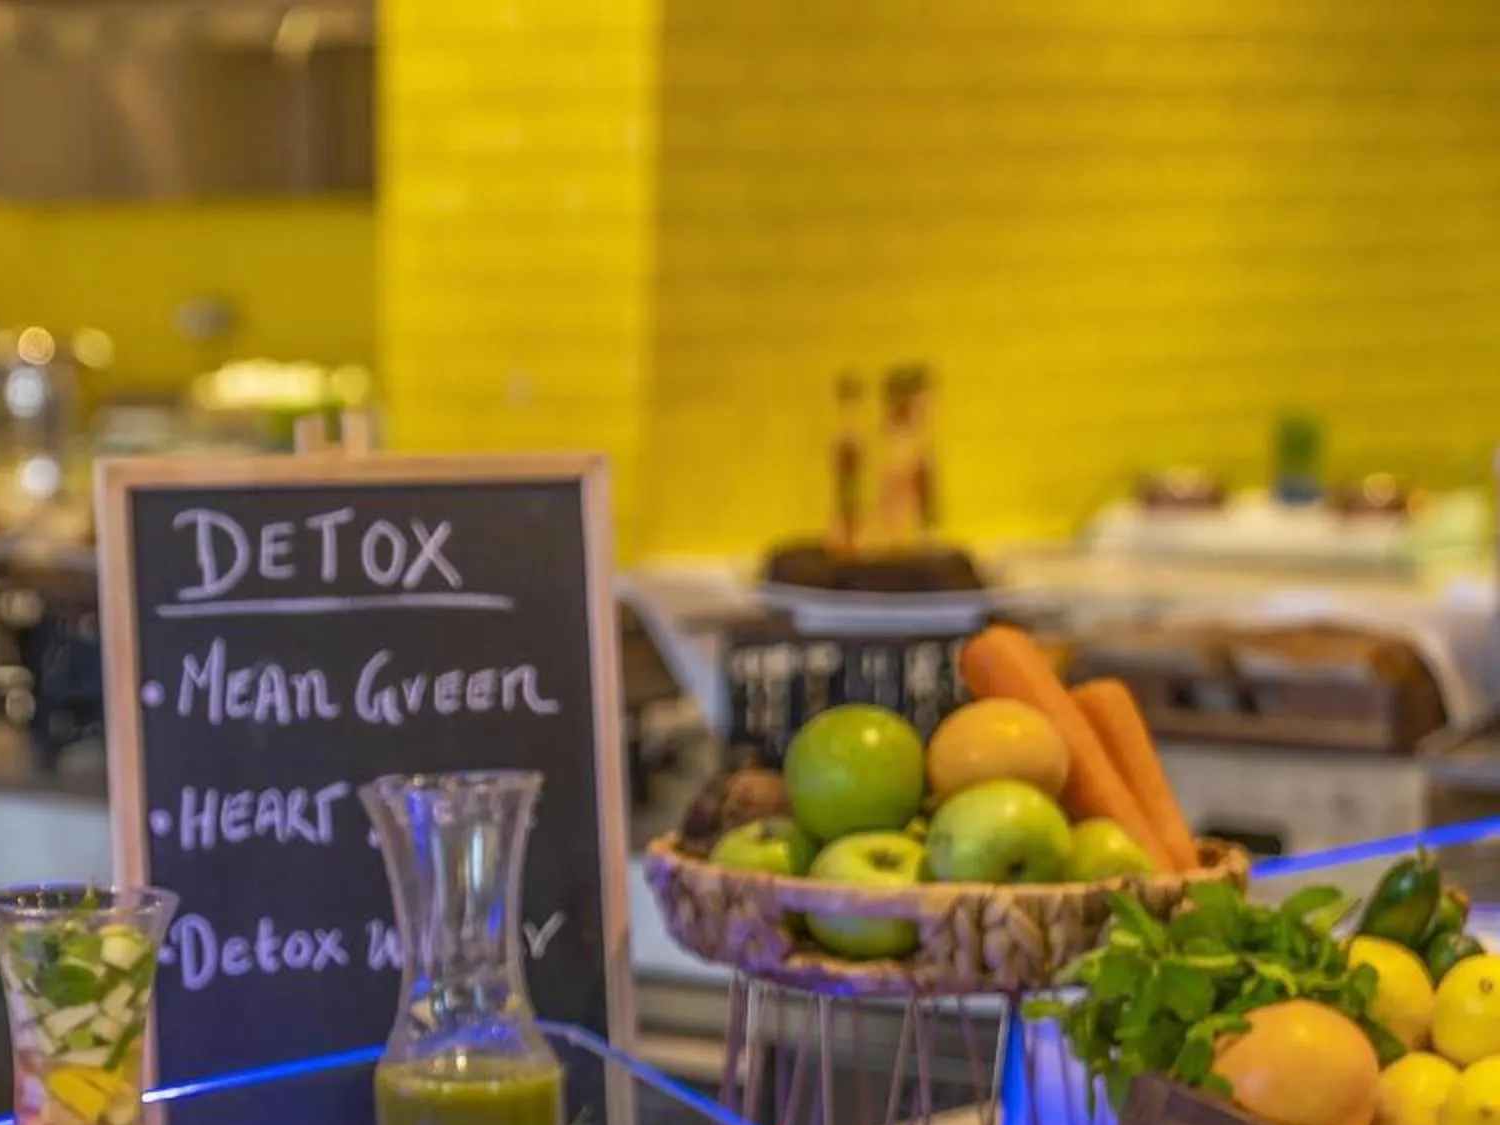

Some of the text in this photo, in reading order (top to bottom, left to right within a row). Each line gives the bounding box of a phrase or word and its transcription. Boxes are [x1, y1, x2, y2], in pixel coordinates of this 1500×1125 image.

[172, 506, 463, 600] DETOX
[179, 780, 351, 851] HEART
[170, 913, 350, 990] Detox
